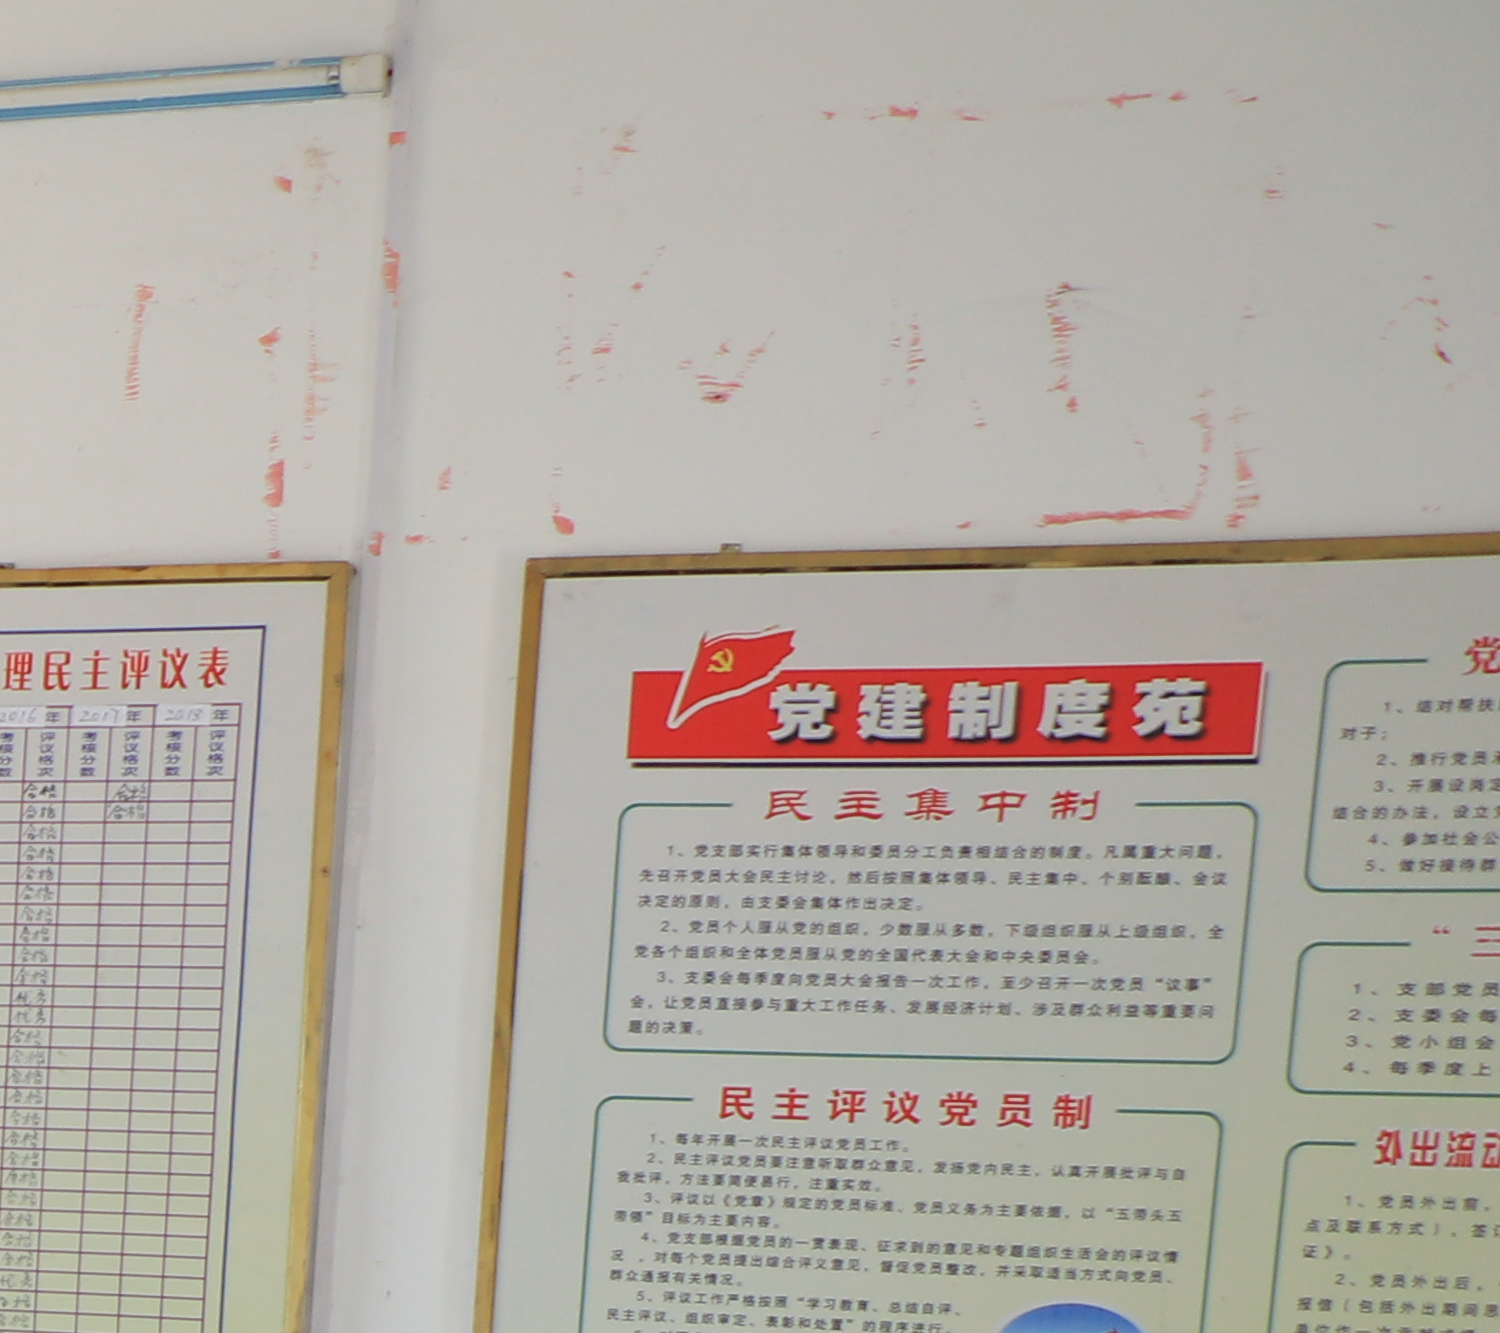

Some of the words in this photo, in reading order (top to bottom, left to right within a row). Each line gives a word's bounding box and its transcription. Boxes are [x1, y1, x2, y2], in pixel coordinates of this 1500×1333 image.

[766, 677, 1210, 744] 党建制度苑
[763, 787, 1101, 824] 民主集中制
[718, 1085, 1094, 1130] 民主评议党员制
